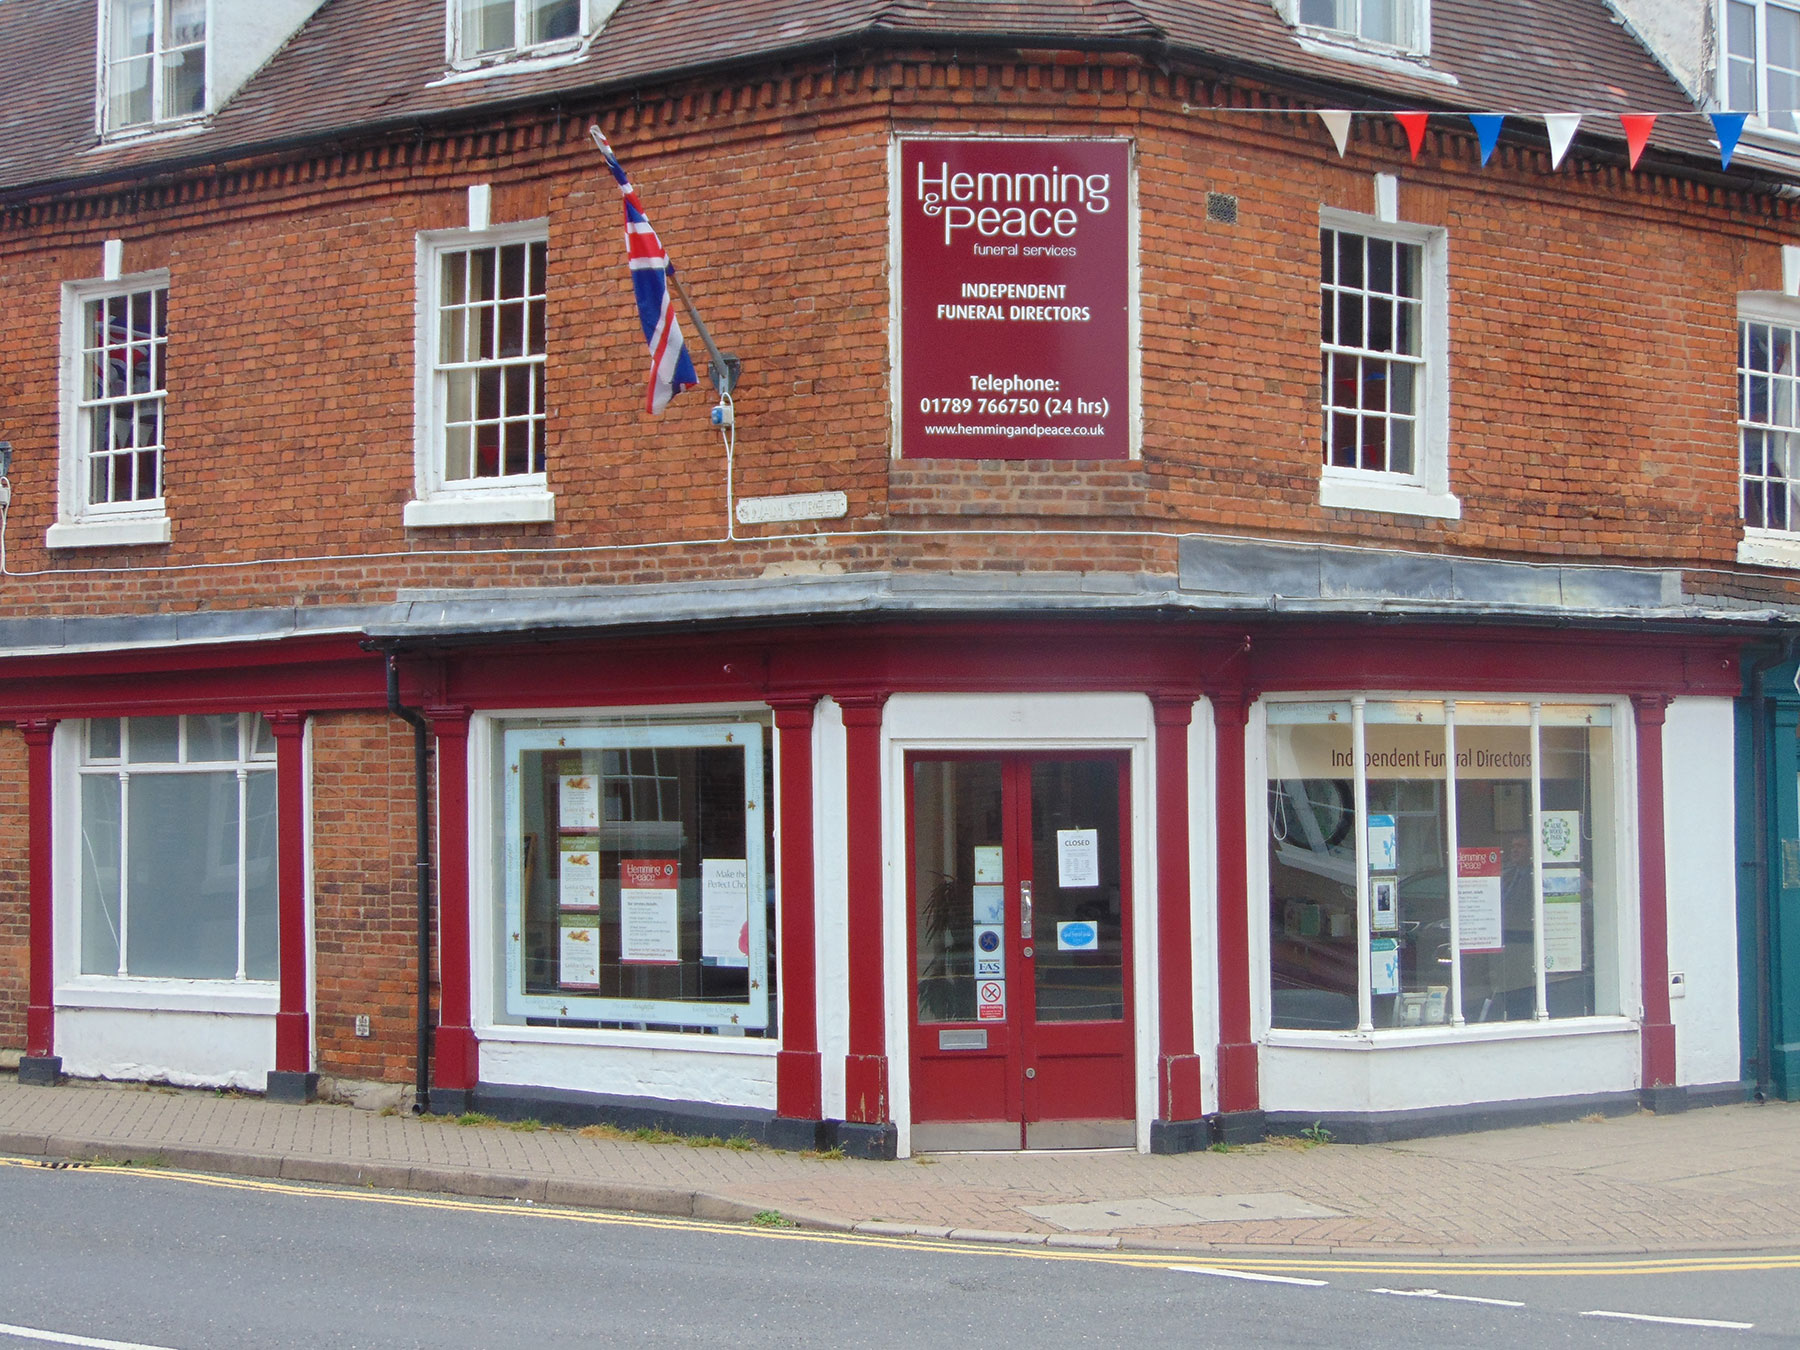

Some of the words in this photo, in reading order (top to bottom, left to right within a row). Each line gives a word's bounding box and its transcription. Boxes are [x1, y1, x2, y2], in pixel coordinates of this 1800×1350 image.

[918, 161, 1110, 213] Hemming
[922, 193, 942, 216] &
[945, 205, 1077, 245] Peace
[973, 243, 1018, 256] funeral
[1023, 244, 1077, 257] services
[961, 282, 1066, 299] INDEPENDENT
[937, 304, 1005, 320] FUNERAL
[1009, 305, 1091, 321] DIRECTORS
[970, 374, 1060, 394] Telephone:
[920, 397, 972, 414] 01789
[977, 398, 1039, 414] 766750
[1044, 397, 1072, 418] (24
[1077, 397, 1110, 418] hrs)
[925, 423, 1105, 438] www.hemmingandpeace.co.uk
[788, 498, 843, 516] STREET
[1331, 748, 1420, 771] Indpendent
[1425, 748, 1472, 767] Funral
[1476, 748, 1532, 768] Directors
[1064, 839, 1090, 847] CLOSED
[626, 863, 661, 876] Hemming
[716, 869, 735, 878] Make
[631, 873, 656, 884] Peace
[707, 880, 731, 889] Perfect
